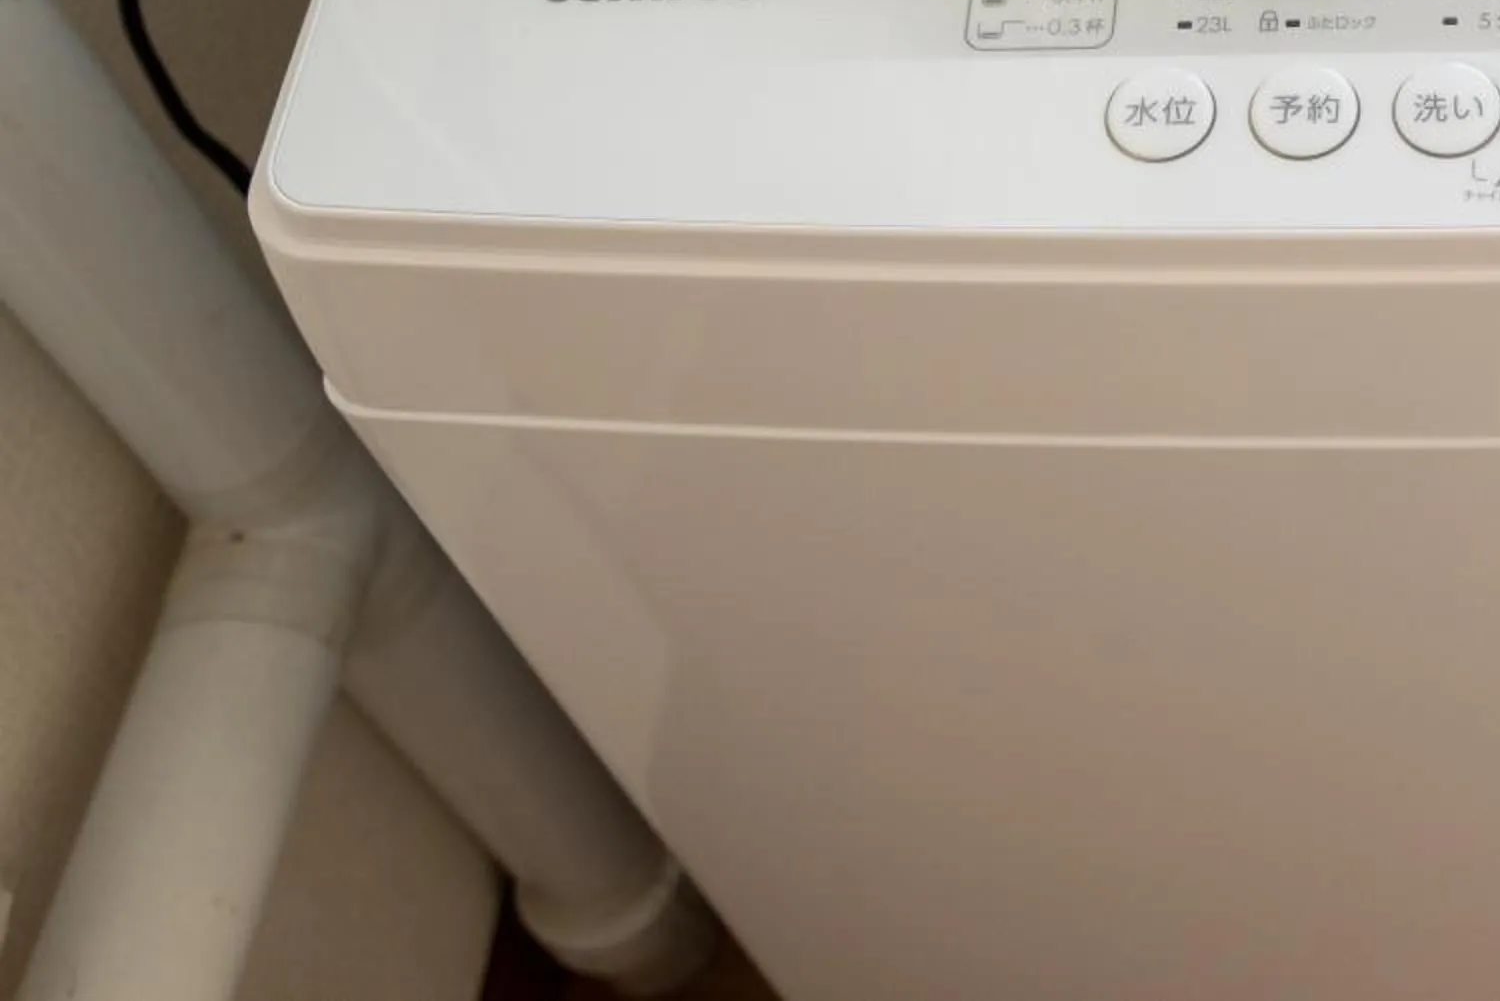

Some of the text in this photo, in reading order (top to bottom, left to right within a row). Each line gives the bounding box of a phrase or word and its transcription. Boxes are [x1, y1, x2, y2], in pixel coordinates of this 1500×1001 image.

[1197, 17, 1232, 33] 23L
[1124, 96, 1197, 127] 水位
[1269, 94, 1341, 125] 予約
[1413, 92, 1484, 123] 洗い
